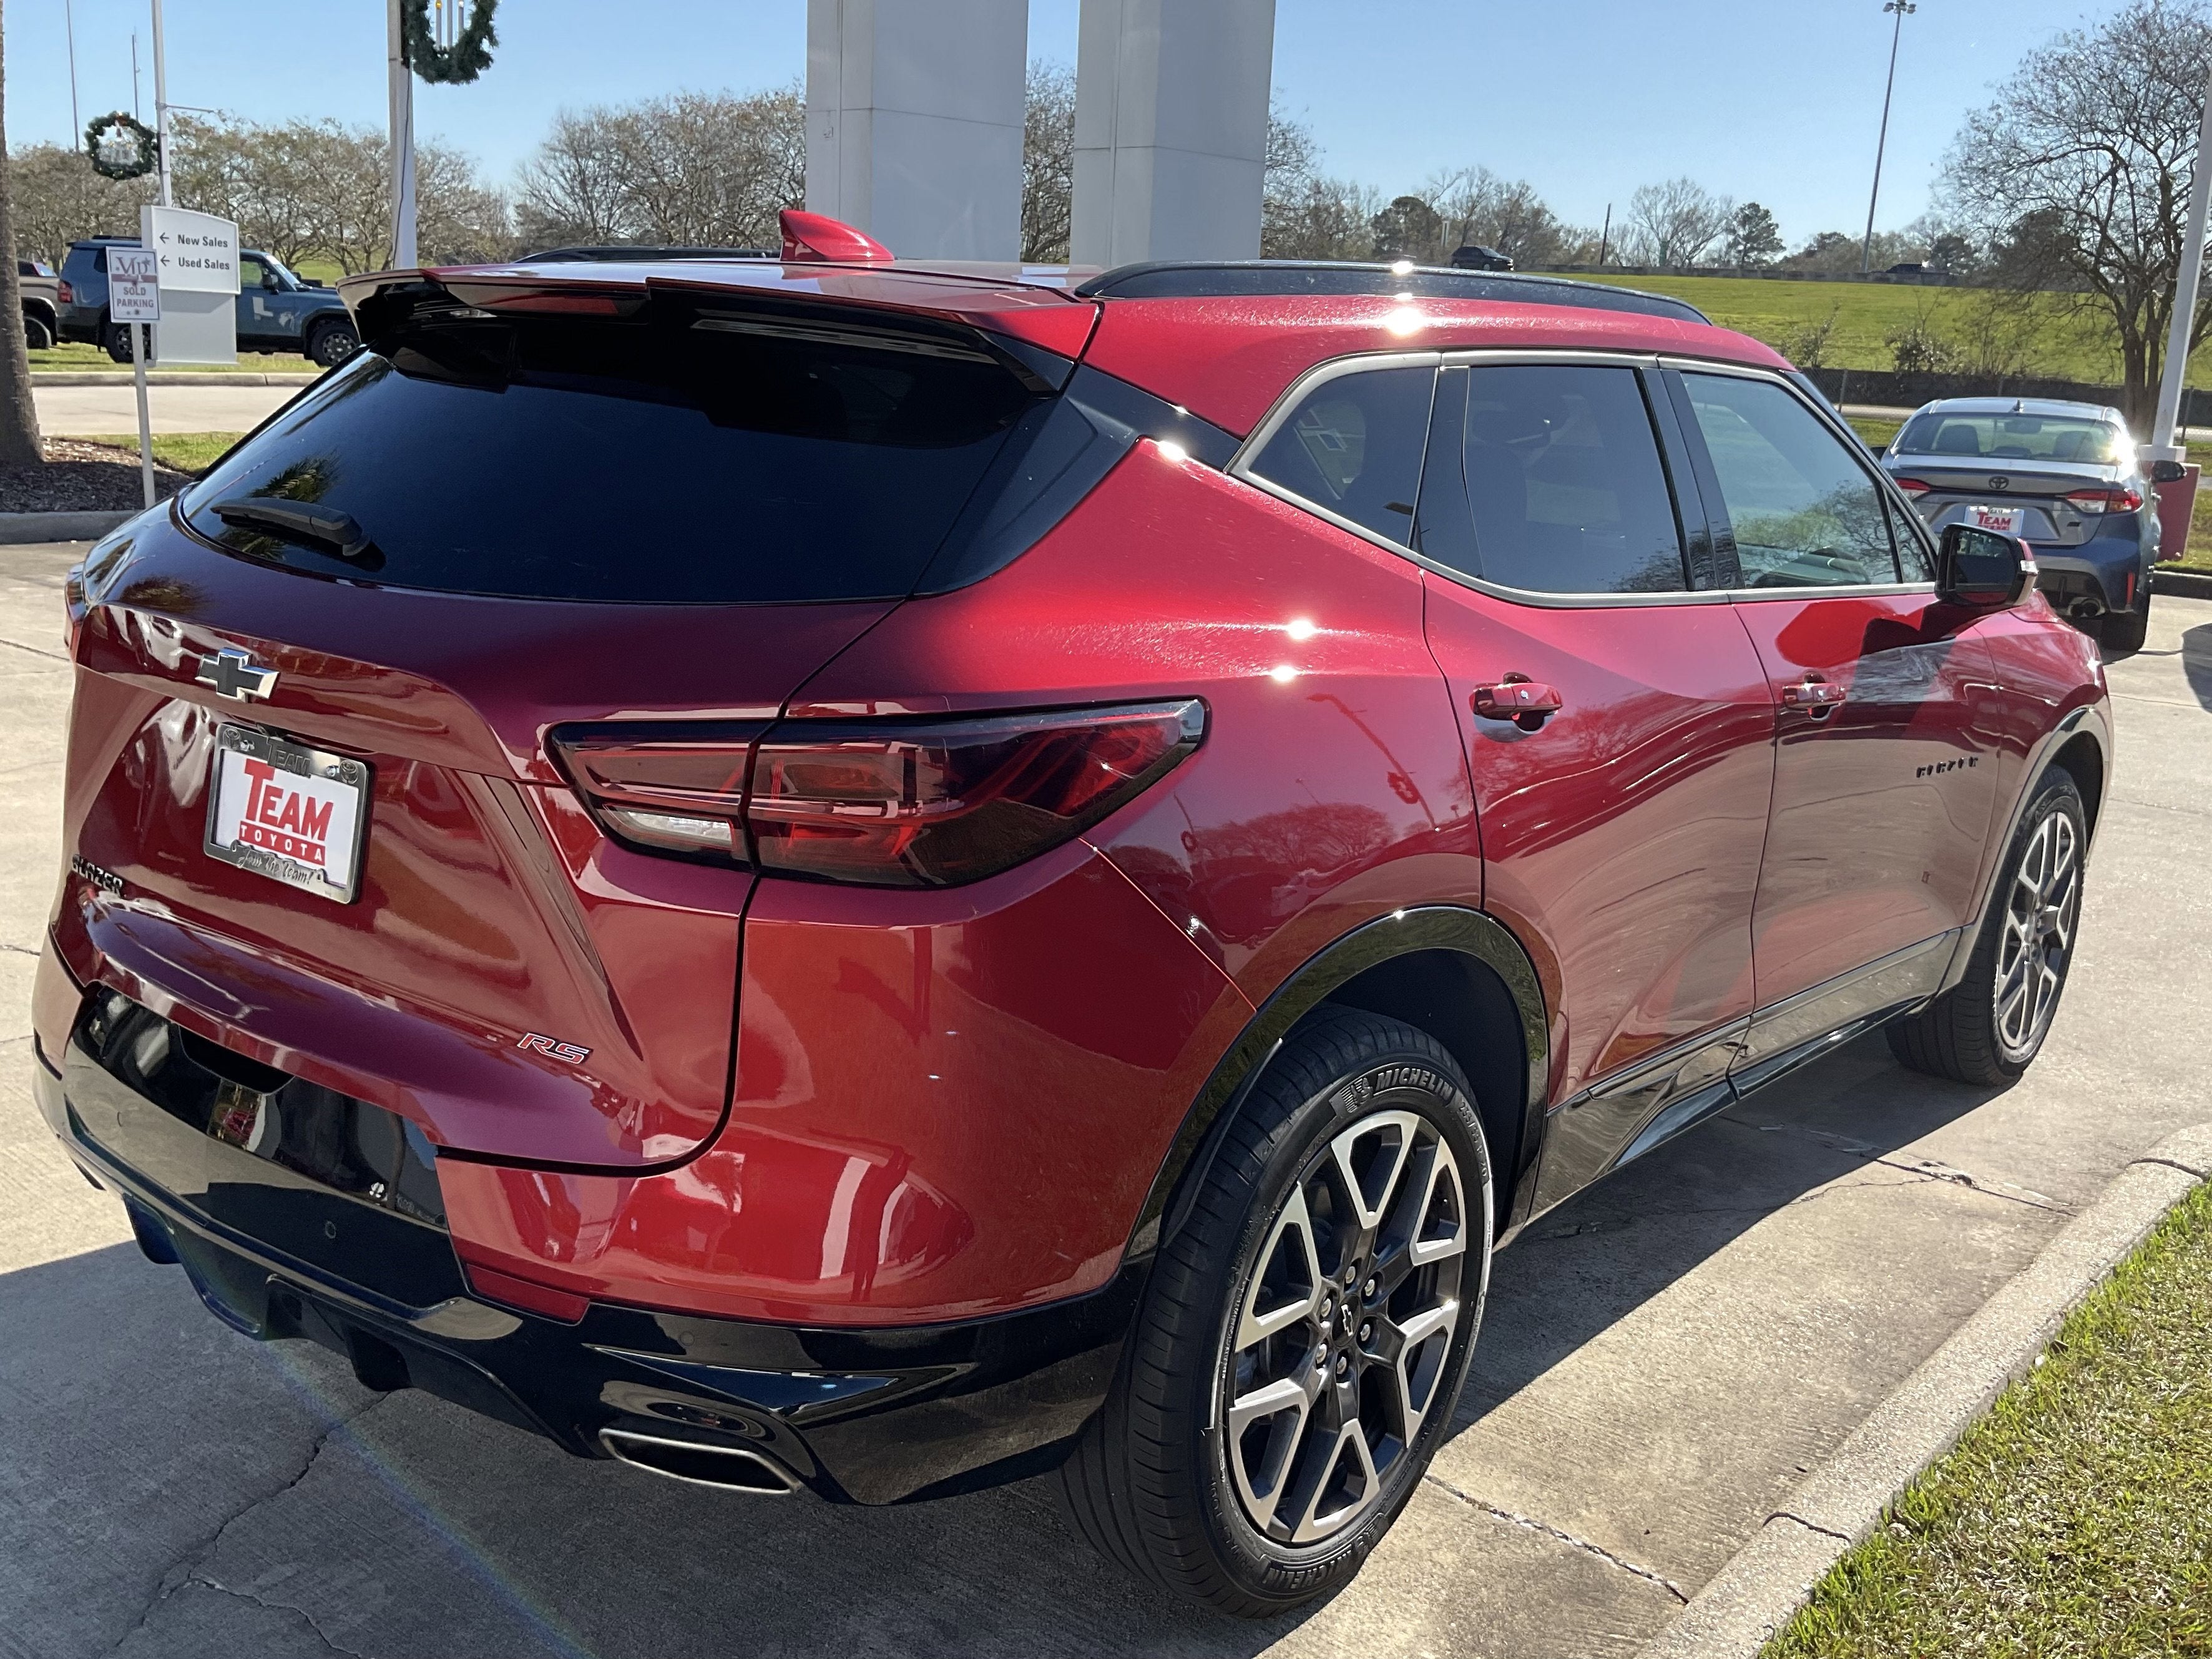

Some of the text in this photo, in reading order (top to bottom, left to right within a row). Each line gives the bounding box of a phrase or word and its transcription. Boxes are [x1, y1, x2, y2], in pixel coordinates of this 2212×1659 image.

[178, 234, 228, 248] New Sales
[179, 257, 230, 270] Used Sales
[117, 298, 154, 308] PARKING
[123, 286, 146, 296] SOLD
[1977, 511, 2012, 526] TEAM
[267, 738, 311, 777] TEAM
[244, 758, 334, 841] TEAM
[240, 824, 323, 862] TOYOTA
[72, 854, 124, 898] BLAZER
[517, 1032, 591, 1064] RS
[1375, 1067, 1454, 1102] MICHELIN
